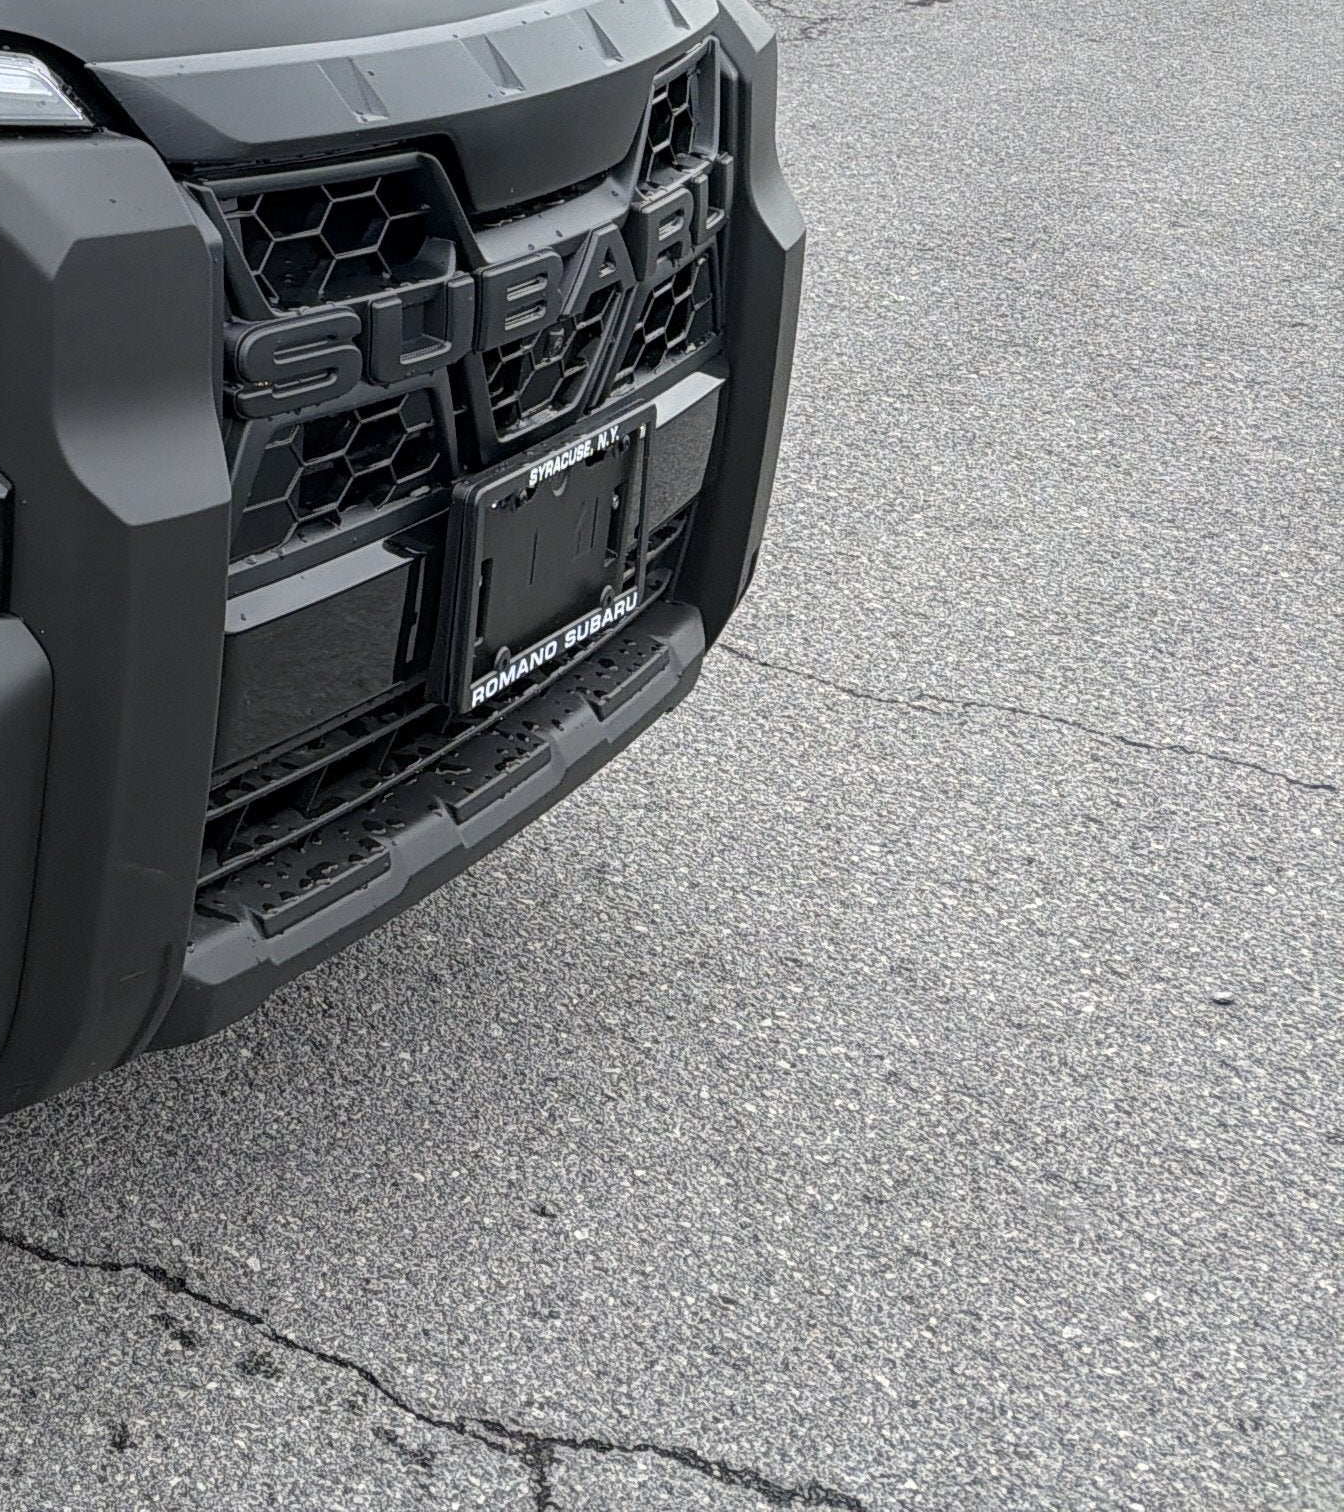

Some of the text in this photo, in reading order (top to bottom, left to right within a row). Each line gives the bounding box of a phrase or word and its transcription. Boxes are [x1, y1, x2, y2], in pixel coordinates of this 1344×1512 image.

[224, 152, 734, 420] SUBARU
[529, 425, 620, 487] SYRACUSE, N.Y.
[471, 591, 639, 709] ROMANO SUBARU
